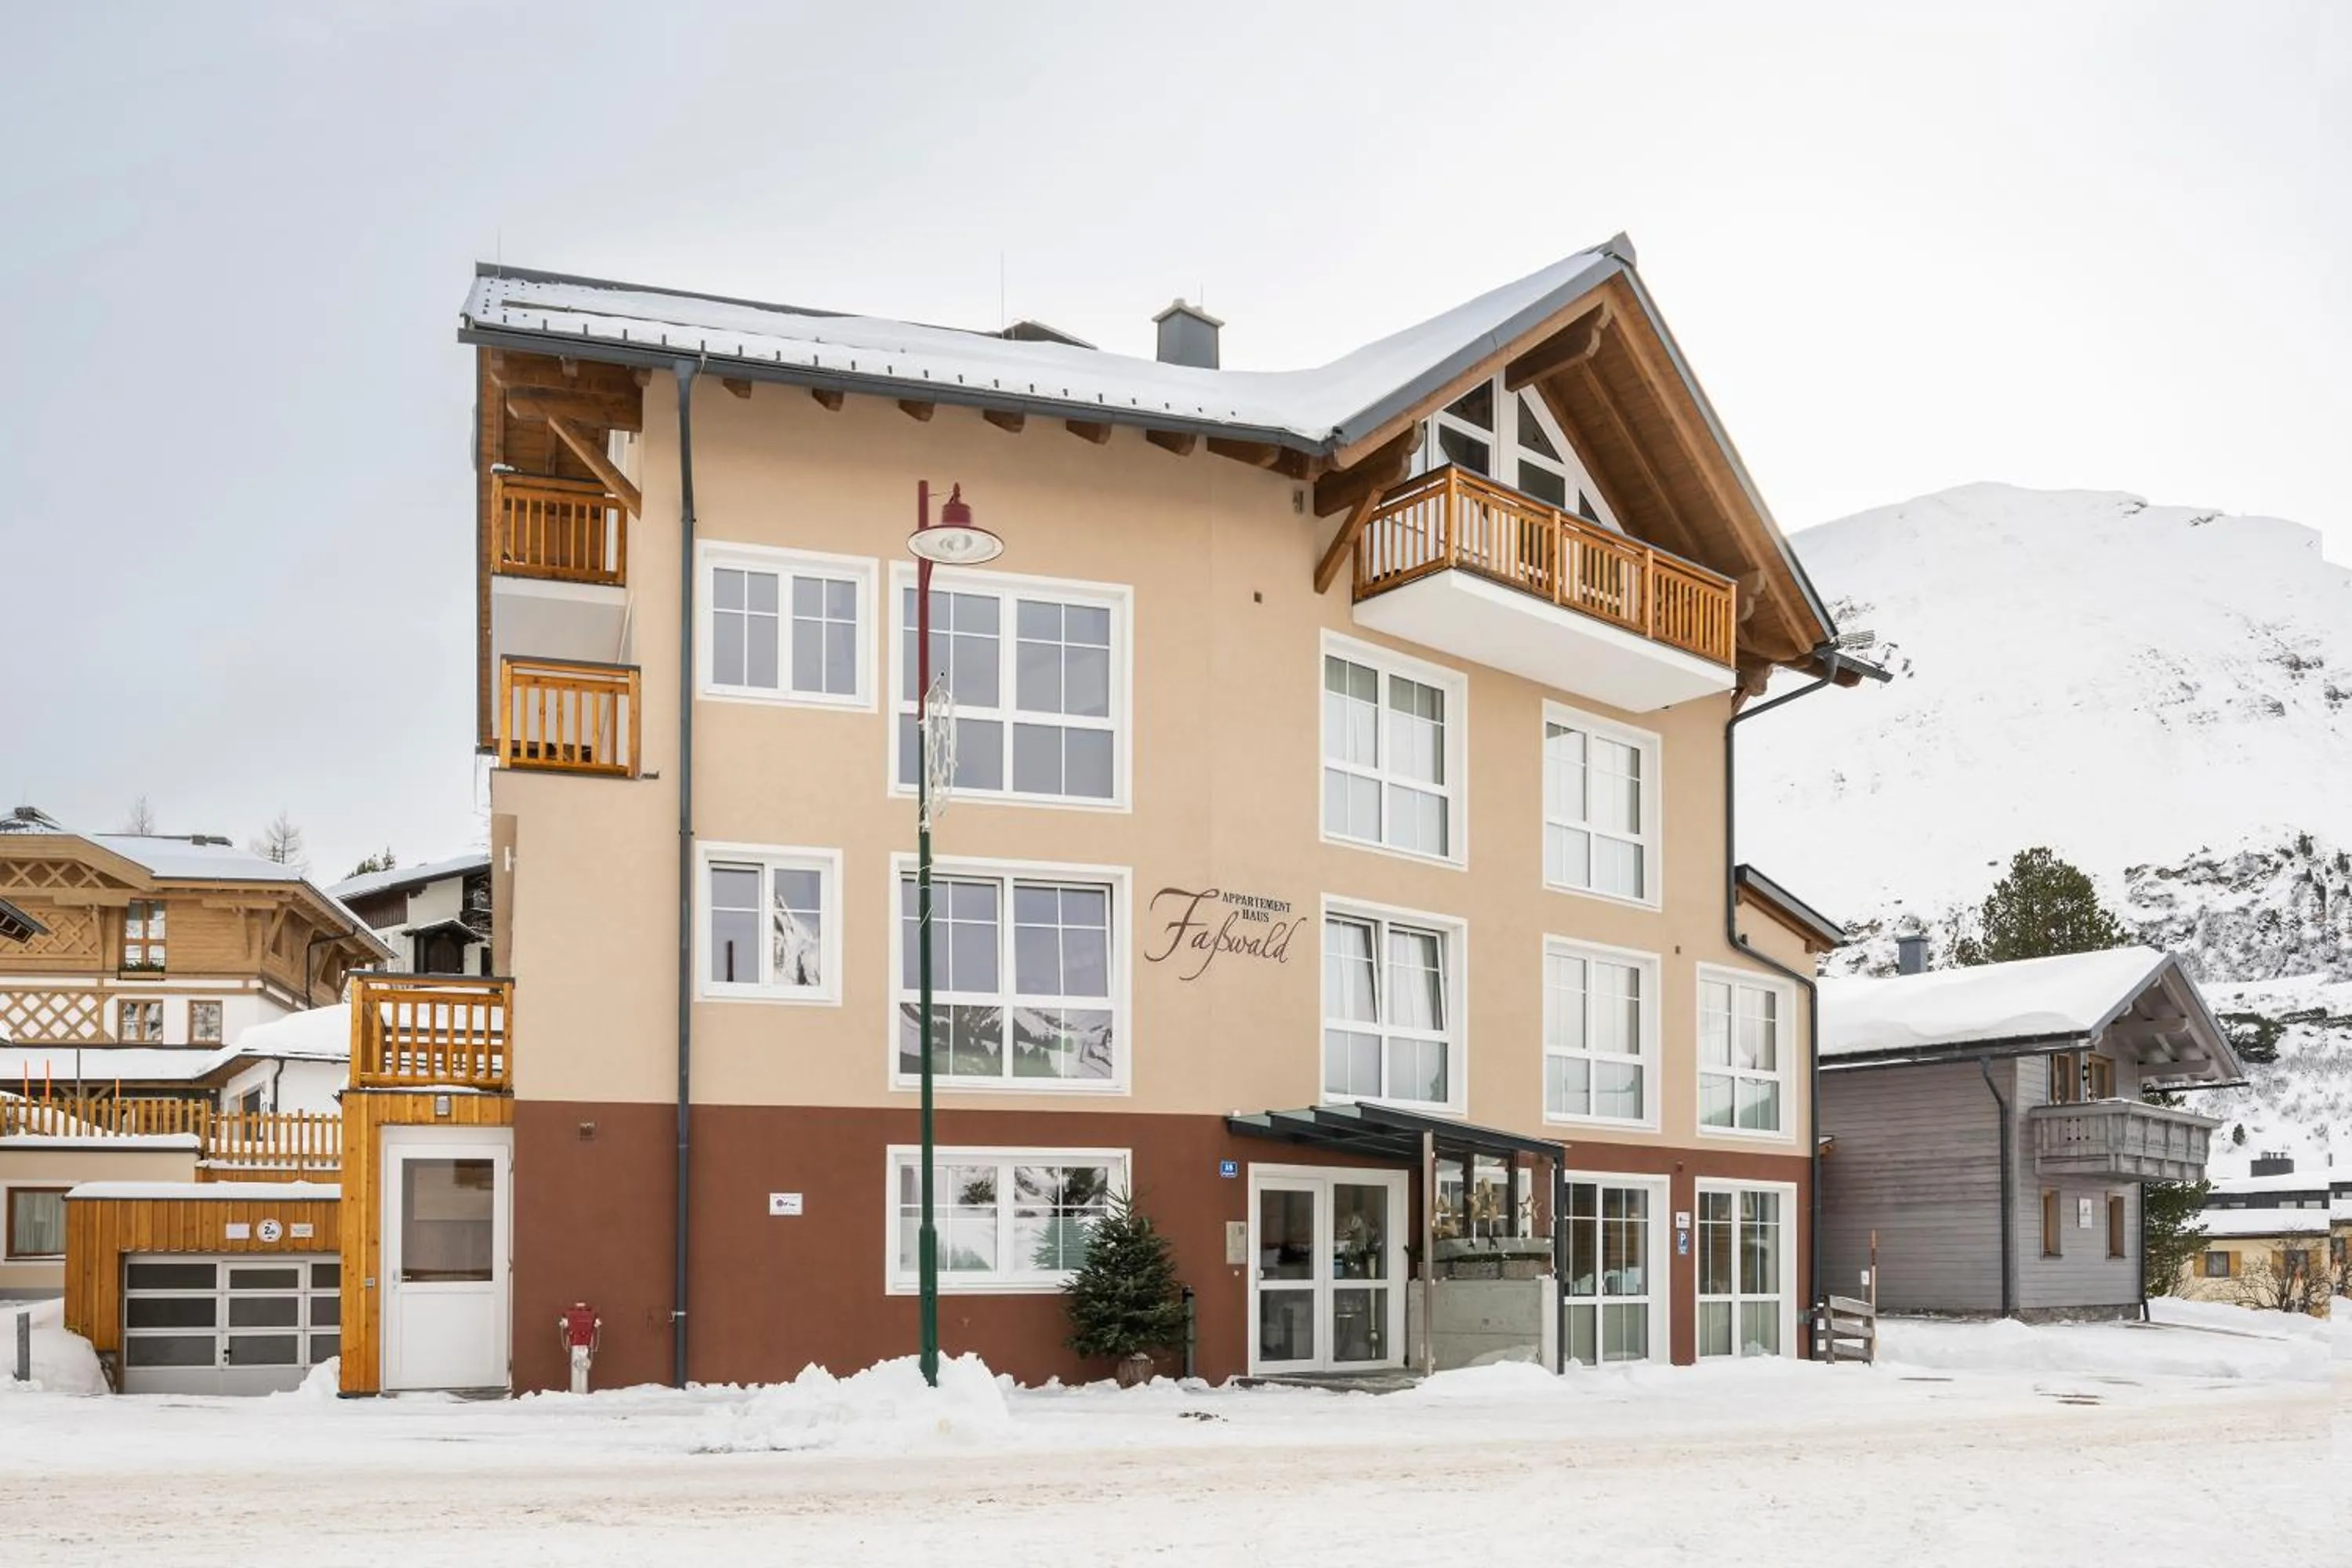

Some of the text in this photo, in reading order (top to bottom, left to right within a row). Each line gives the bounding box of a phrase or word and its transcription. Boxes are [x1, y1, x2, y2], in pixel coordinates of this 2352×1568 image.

[1221, 891, 1292, 913] APPARTEMENT
[1242, 909, 1270, 923] HAUS
[1144, 887, 1308, 982] Faßwald
